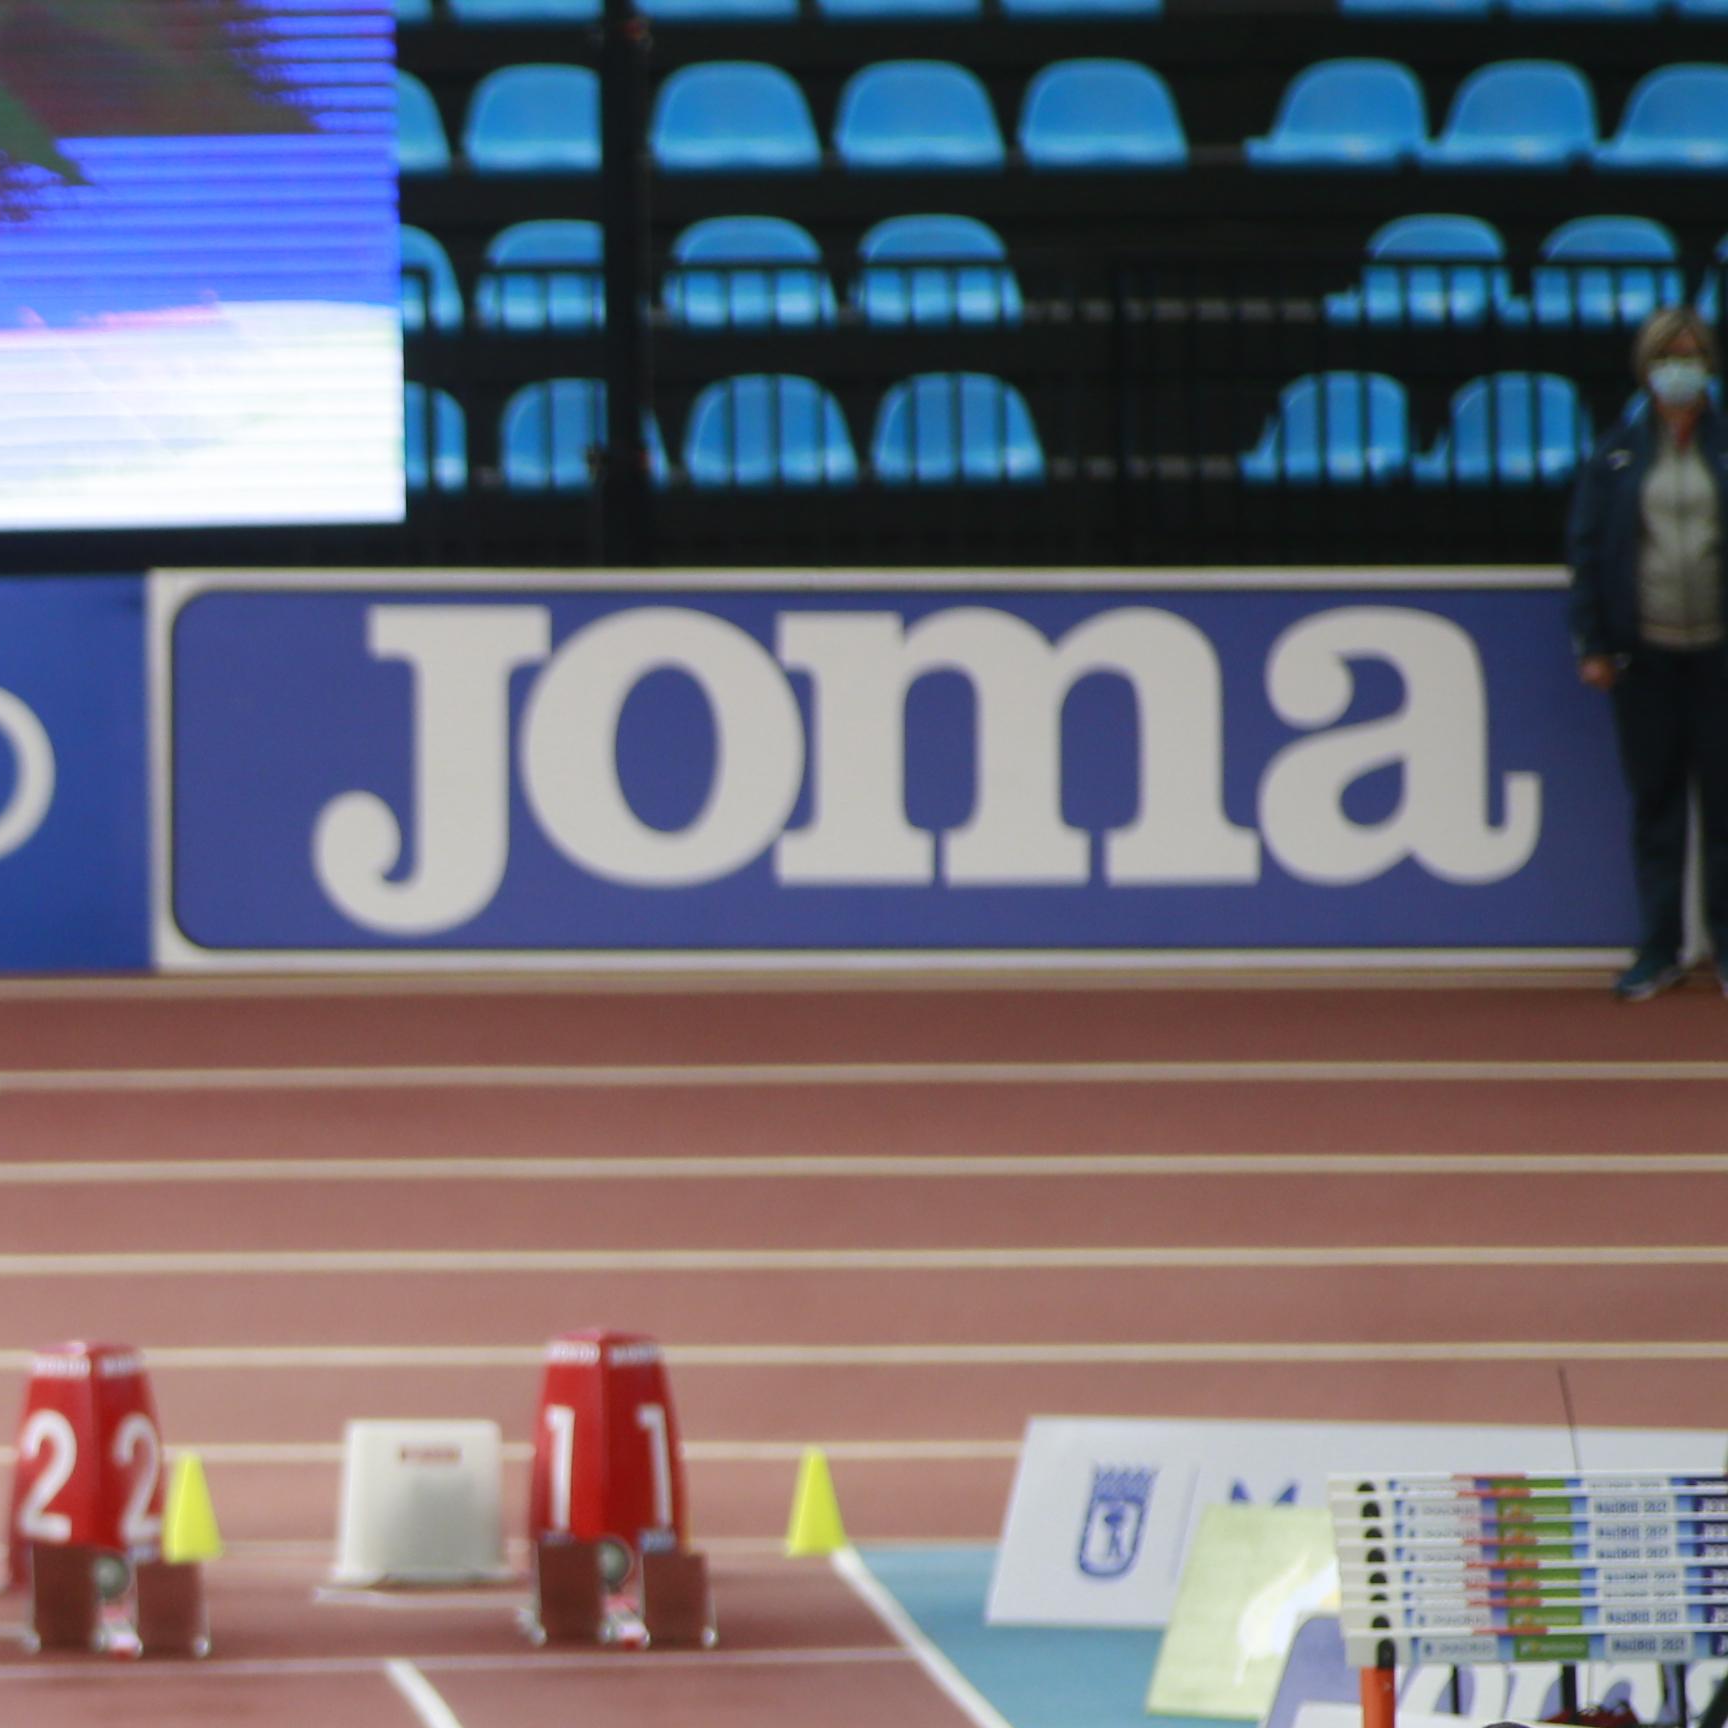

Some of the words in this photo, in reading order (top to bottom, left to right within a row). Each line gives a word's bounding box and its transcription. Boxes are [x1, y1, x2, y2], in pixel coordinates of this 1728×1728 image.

[311, 604, 1541, 937] Joma
[19, 1408, 77, 1542] 2
[112, 1412, 163, 1542] 2
[545, 1404, 575, 1531] 1
[636, 1402, 673, 1531] 1
